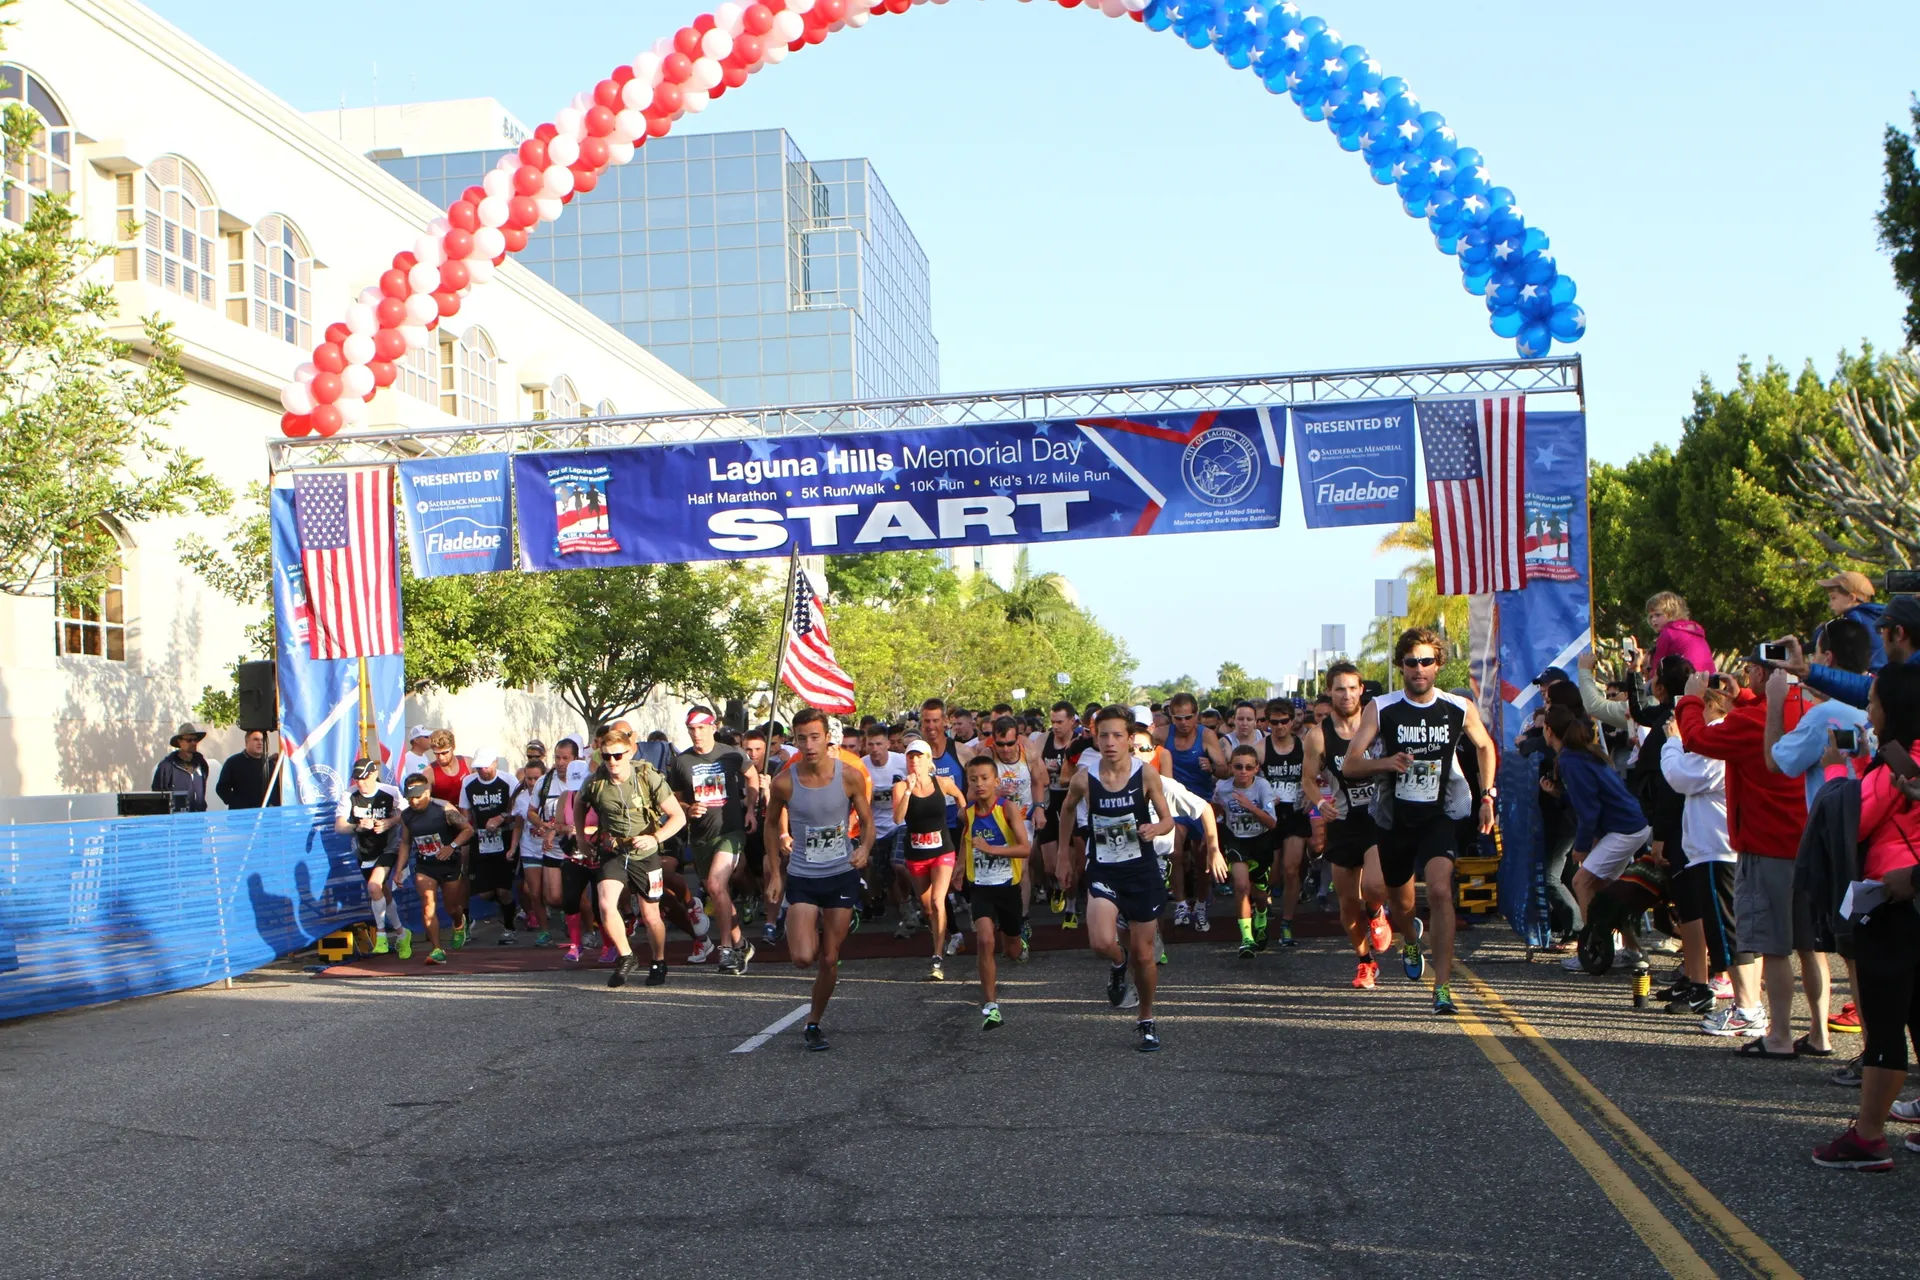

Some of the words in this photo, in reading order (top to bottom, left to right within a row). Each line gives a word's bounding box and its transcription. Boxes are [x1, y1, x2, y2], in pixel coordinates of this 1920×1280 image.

[1305, 418, 1380, 434] PRESENTED
[1384, 416, 1401, 429] BY
[1207, 430, 1236, 439] LAGUNA
[1239, 437, 1255, 457] HILLS
[1321, 447, 1363, 456] SADDLEBACK
[1364, 444, 1402, 453] MEMORIAL
[569, 466, 592, 474] Laguna
[709, 457, 818, 485] Laguna
[827, 448, 894, 474] Hills
[902, 439, 1022, 470] Memorial
[1032, 438, 1083, 465] Day
[412, 471, 482, 488] PRESENTED
[484, 469, 500, 482] BY
[688, 492, 713, 505] Half
[717, 490, 777, 503] Marathon
[801, 487, 819, 499] 5K
[823, 483, 885, 498] Run/Walk
[910, 481, 935, 492] 10K
[939, 480, 965, 491] Run
[989, 475, 1022, 488] Kid's
[1027, 473, 1047, 486] 1/2
[1052, 471, 1080, 484] Mile
[1084, 471, 1110, 482] Run
[1317, 480, 1399, 504] Fladeboe
[468, 496, 502, 505] MEMORIAL
[707, 490, 1090, 552] START
[427, 530, 502, 553] Fladeboe
[1397, 724, 1427, 744] SNAIL'S
[1429, 724, 1450, 744] PACE
[1398, 774, 1438, 790] 1430
[490, 793, 502, 804] PACE
[1100, 796, 1136, 808] LOYOLA
[806, 836, 844, 851] 1735
[1107, 834, 1126, 851] 69
